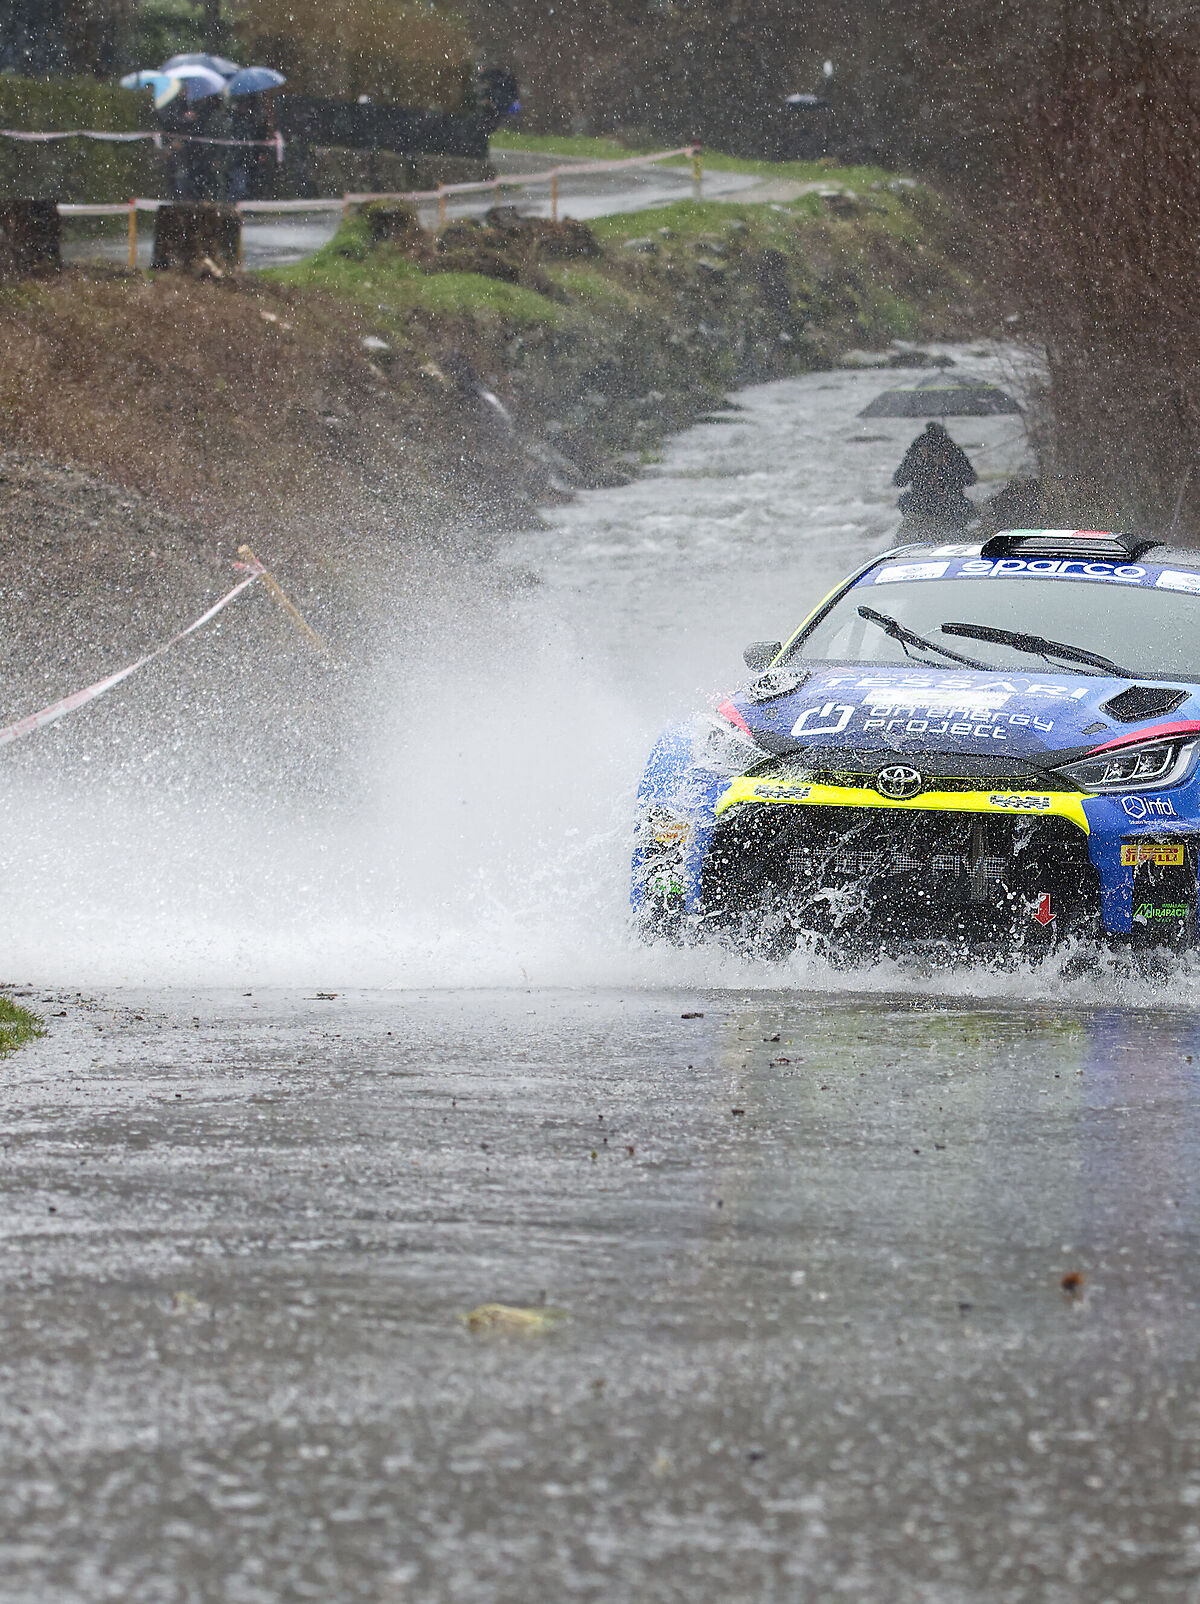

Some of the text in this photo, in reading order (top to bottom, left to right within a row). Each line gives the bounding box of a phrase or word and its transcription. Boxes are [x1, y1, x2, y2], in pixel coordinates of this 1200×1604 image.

[961, 558, 1147, 579] sparco
[821, 677, 1090, 700] TESSARI
[1125, 848, 1179, 862] PIRELLI
